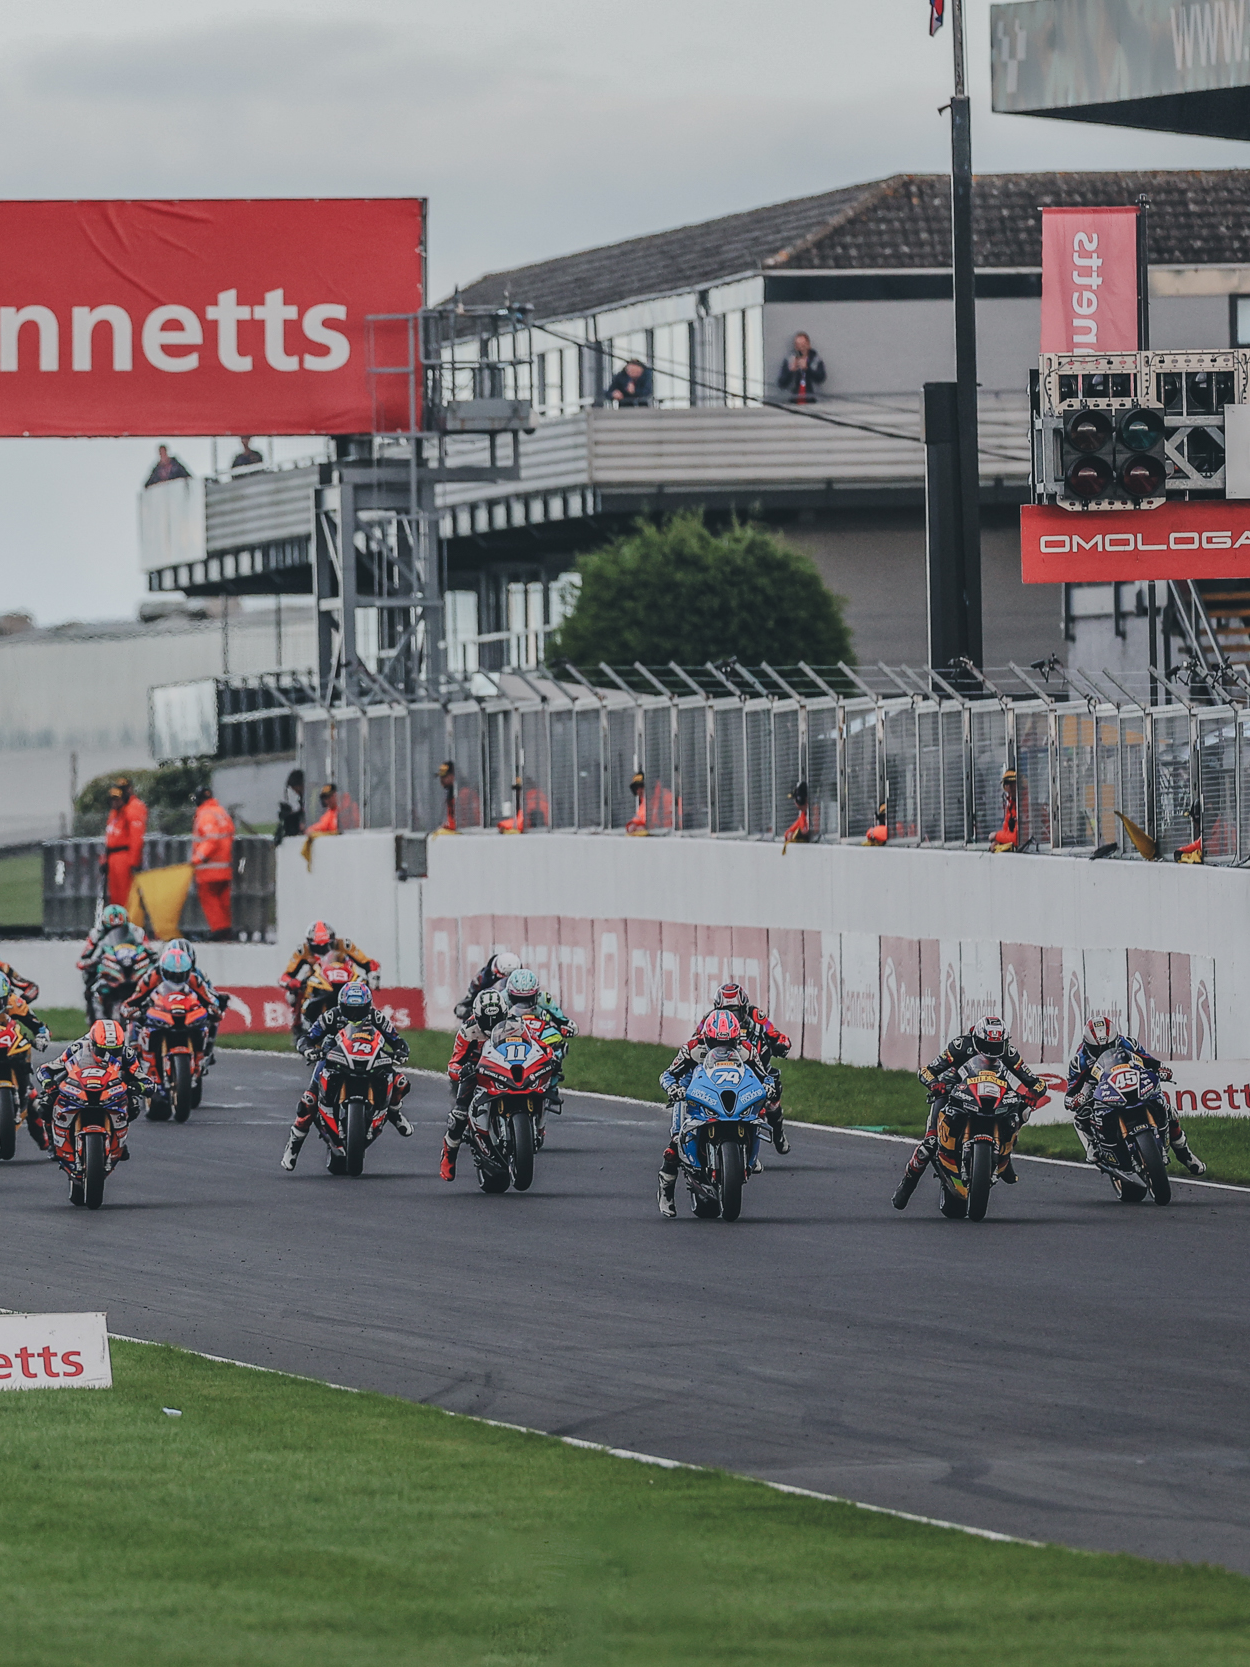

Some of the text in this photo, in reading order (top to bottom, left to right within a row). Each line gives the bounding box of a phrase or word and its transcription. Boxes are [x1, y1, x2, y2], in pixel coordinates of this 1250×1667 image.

[351, 1041, 374, 1054] 14
[504, 1044, 527, 1061] 11
[81, 1067, 107, 1078] 19
[715, 1071, 741, 1085] 74
[1114, 1071, 1138, 1089] 45
